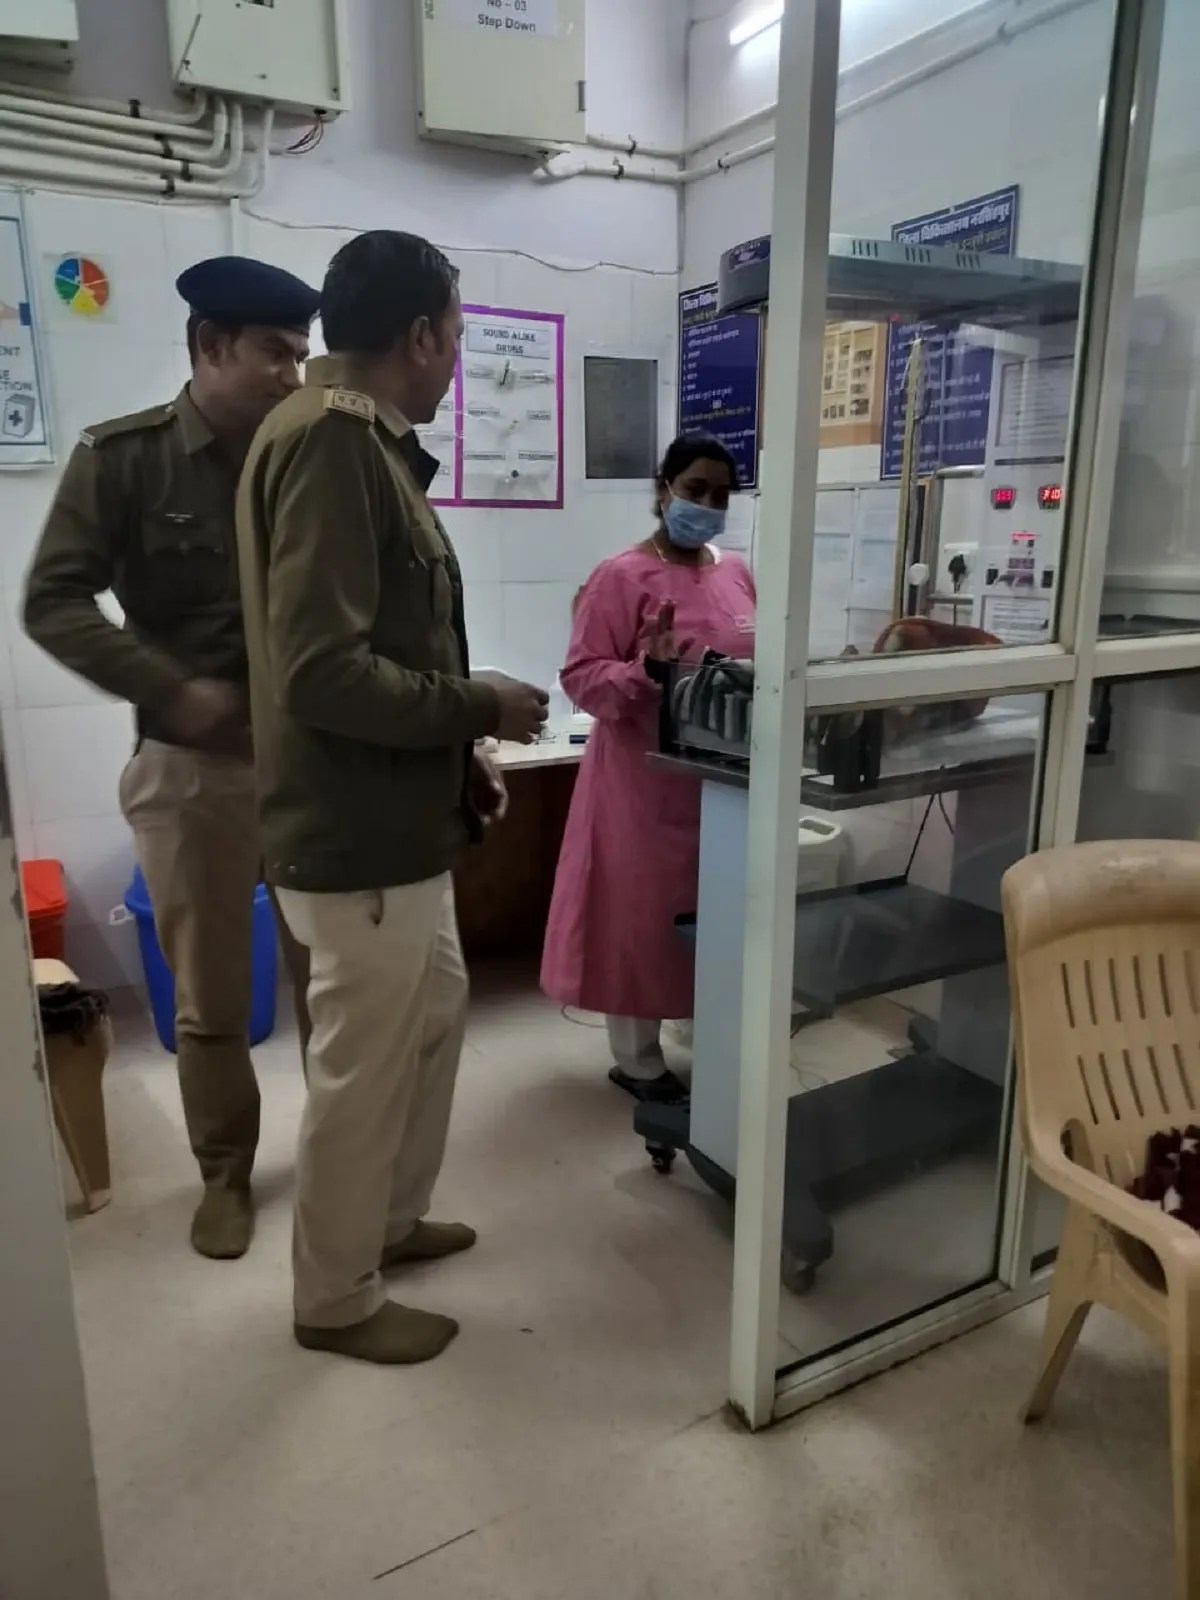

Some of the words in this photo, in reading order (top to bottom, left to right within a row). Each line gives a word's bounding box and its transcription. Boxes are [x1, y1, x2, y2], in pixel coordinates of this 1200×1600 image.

[514, 0, 527, 11] 03
[478, 13, 502, 29] Step
[505, 17, 536, 32] Down
[483, 328, 510, 340] SOUND
[511, 332, 536, 343] ALIKE
[496, 343, 524, 355] DRUGS
